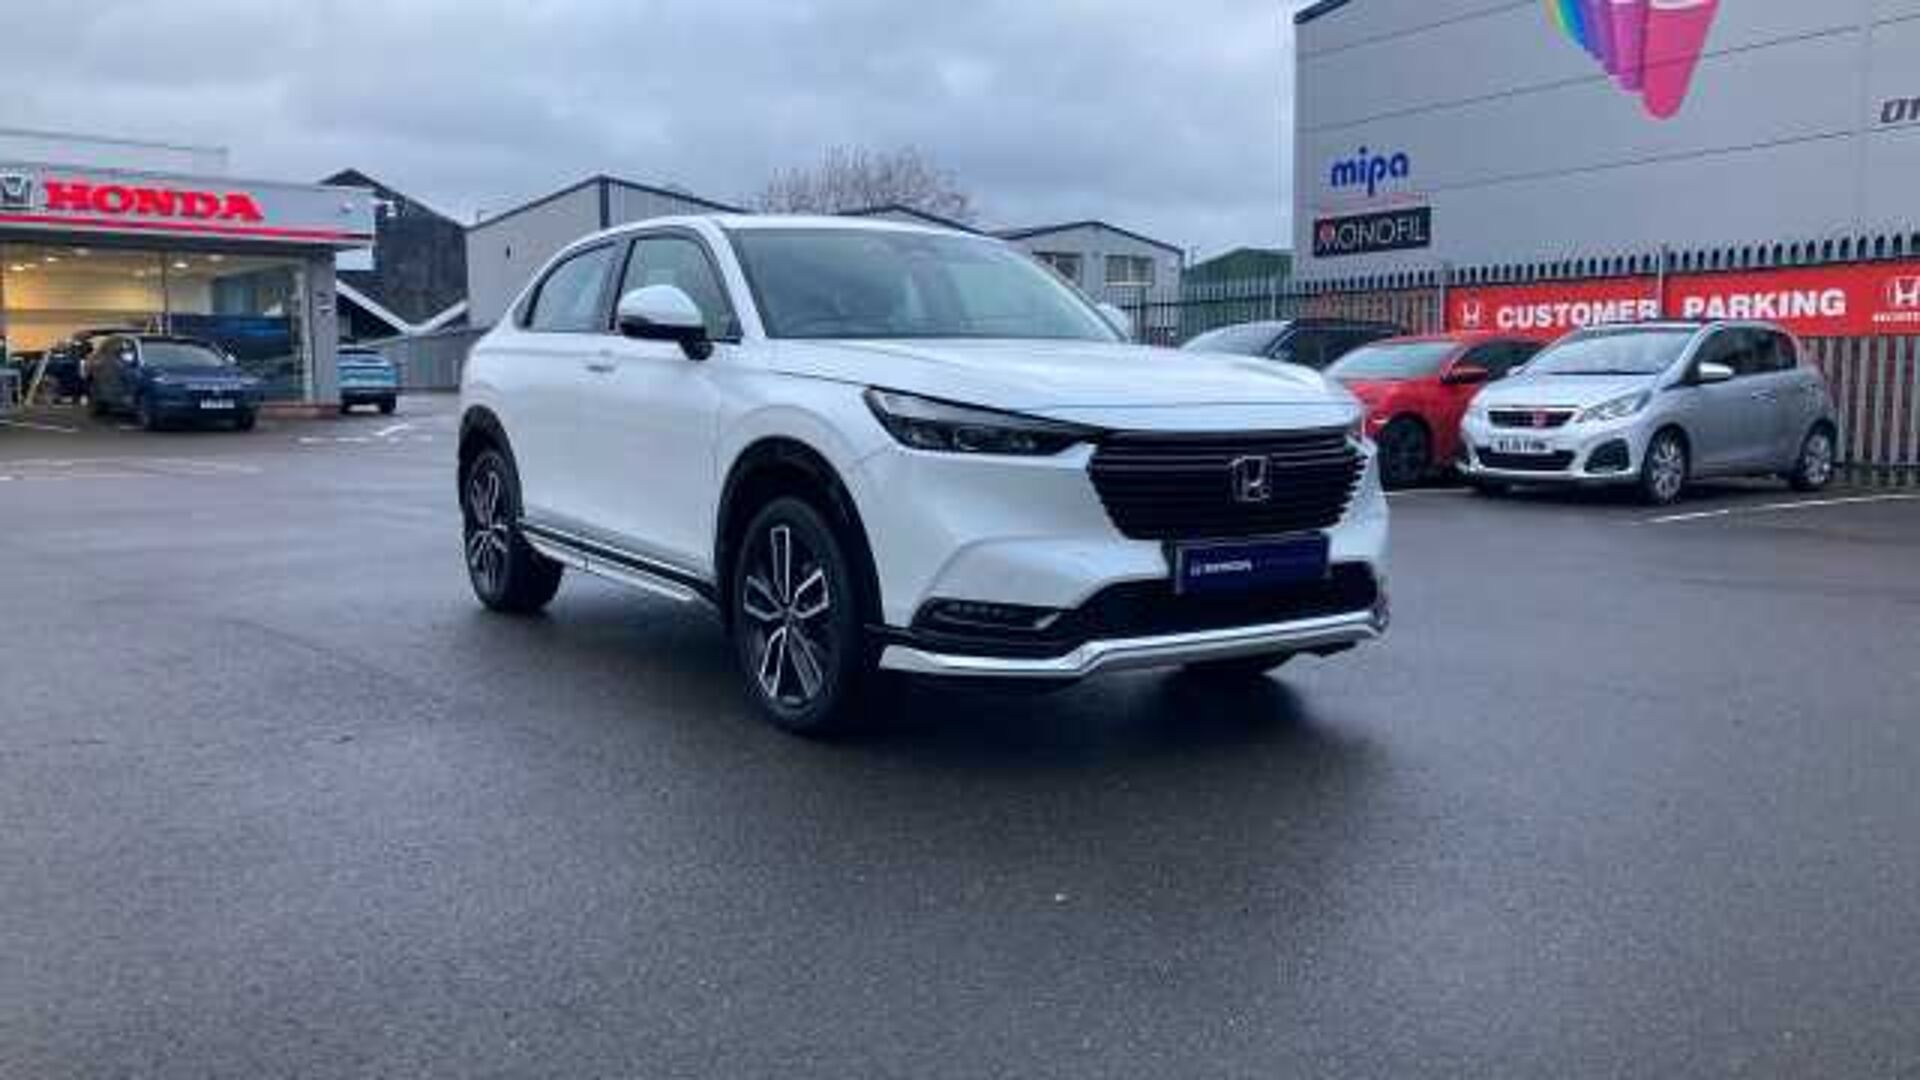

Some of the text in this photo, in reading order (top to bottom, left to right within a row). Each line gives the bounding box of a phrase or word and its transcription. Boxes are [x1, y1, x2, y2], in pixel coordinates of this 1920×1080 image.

[1330, 146, 1408, 198] mipa
[46, 181, 264, 222] HONDA
[1496, 300, 1659, 329] CUSTOMER
[1682, 288, 1847, 319] PARKING
